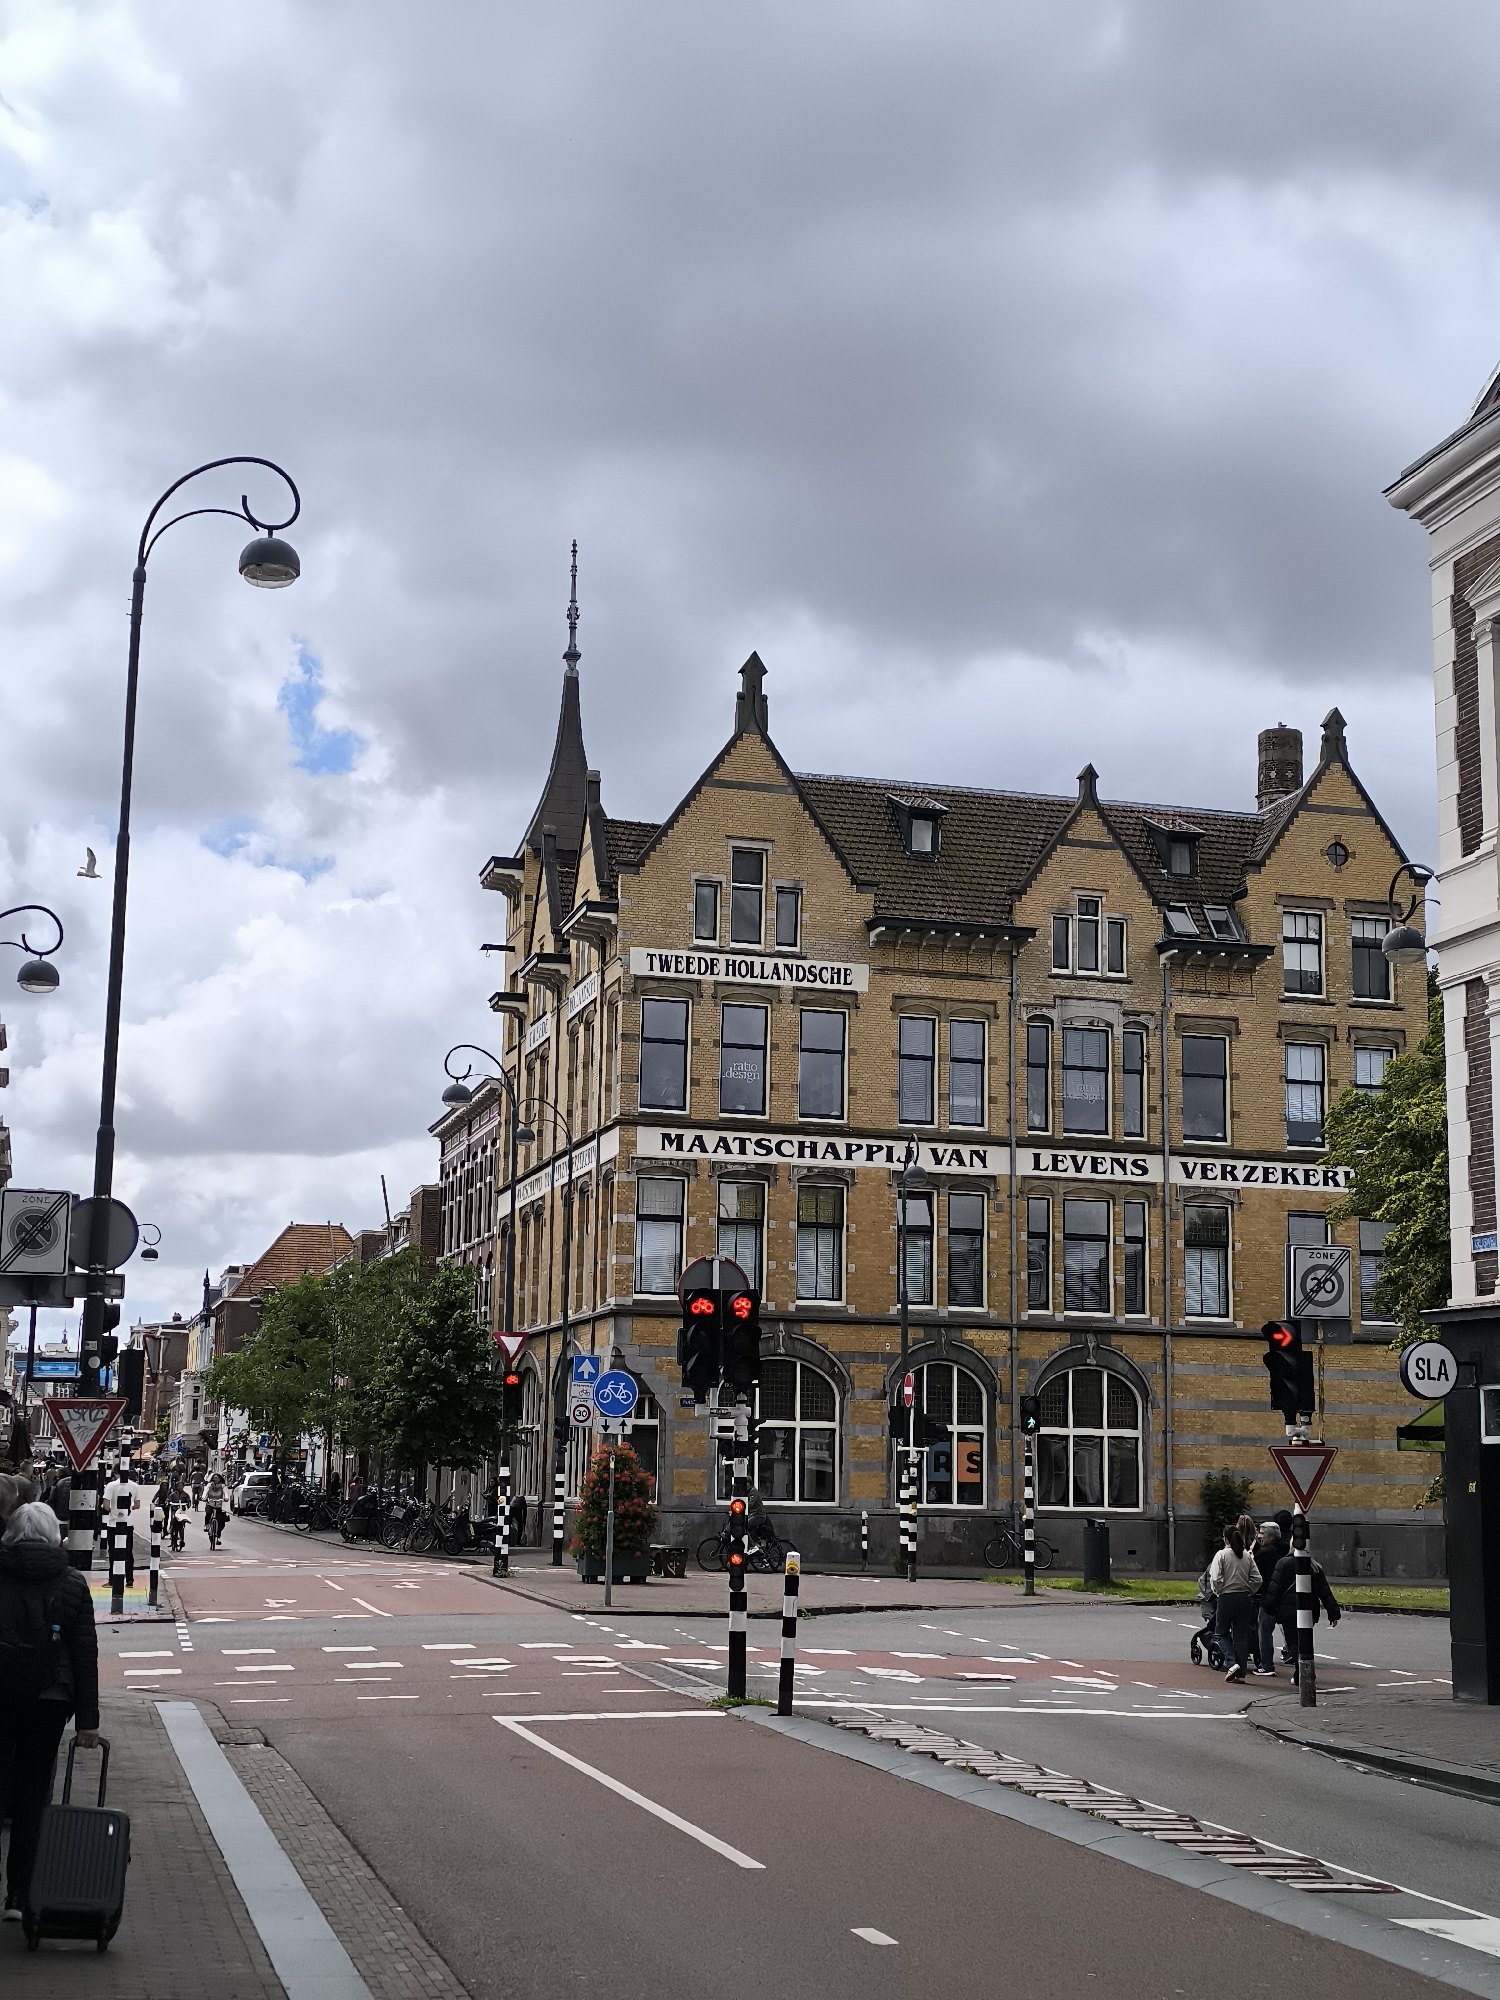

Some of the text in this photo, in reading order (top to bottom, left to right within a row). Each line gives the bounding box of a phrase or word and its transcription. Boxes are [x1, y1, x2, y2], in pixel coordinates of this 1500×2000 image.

[646, 952, 854, 986] TWEEDE HOLLANDSCHE
[732, 1061, 758, 1072] ratio
[660, 1132, 1358, 1188] MAATSCHAPPIJ VAN LEVENS VERZEKERI
[22, 1195, 51, 1204] ZONE
[1309, 1251, 1336, 1260] ZONE
[1415, 1357, 1450, 1382] SLA
[575, 1409, 588, 1418] 30
[966, 1451, 981, 1473] S
